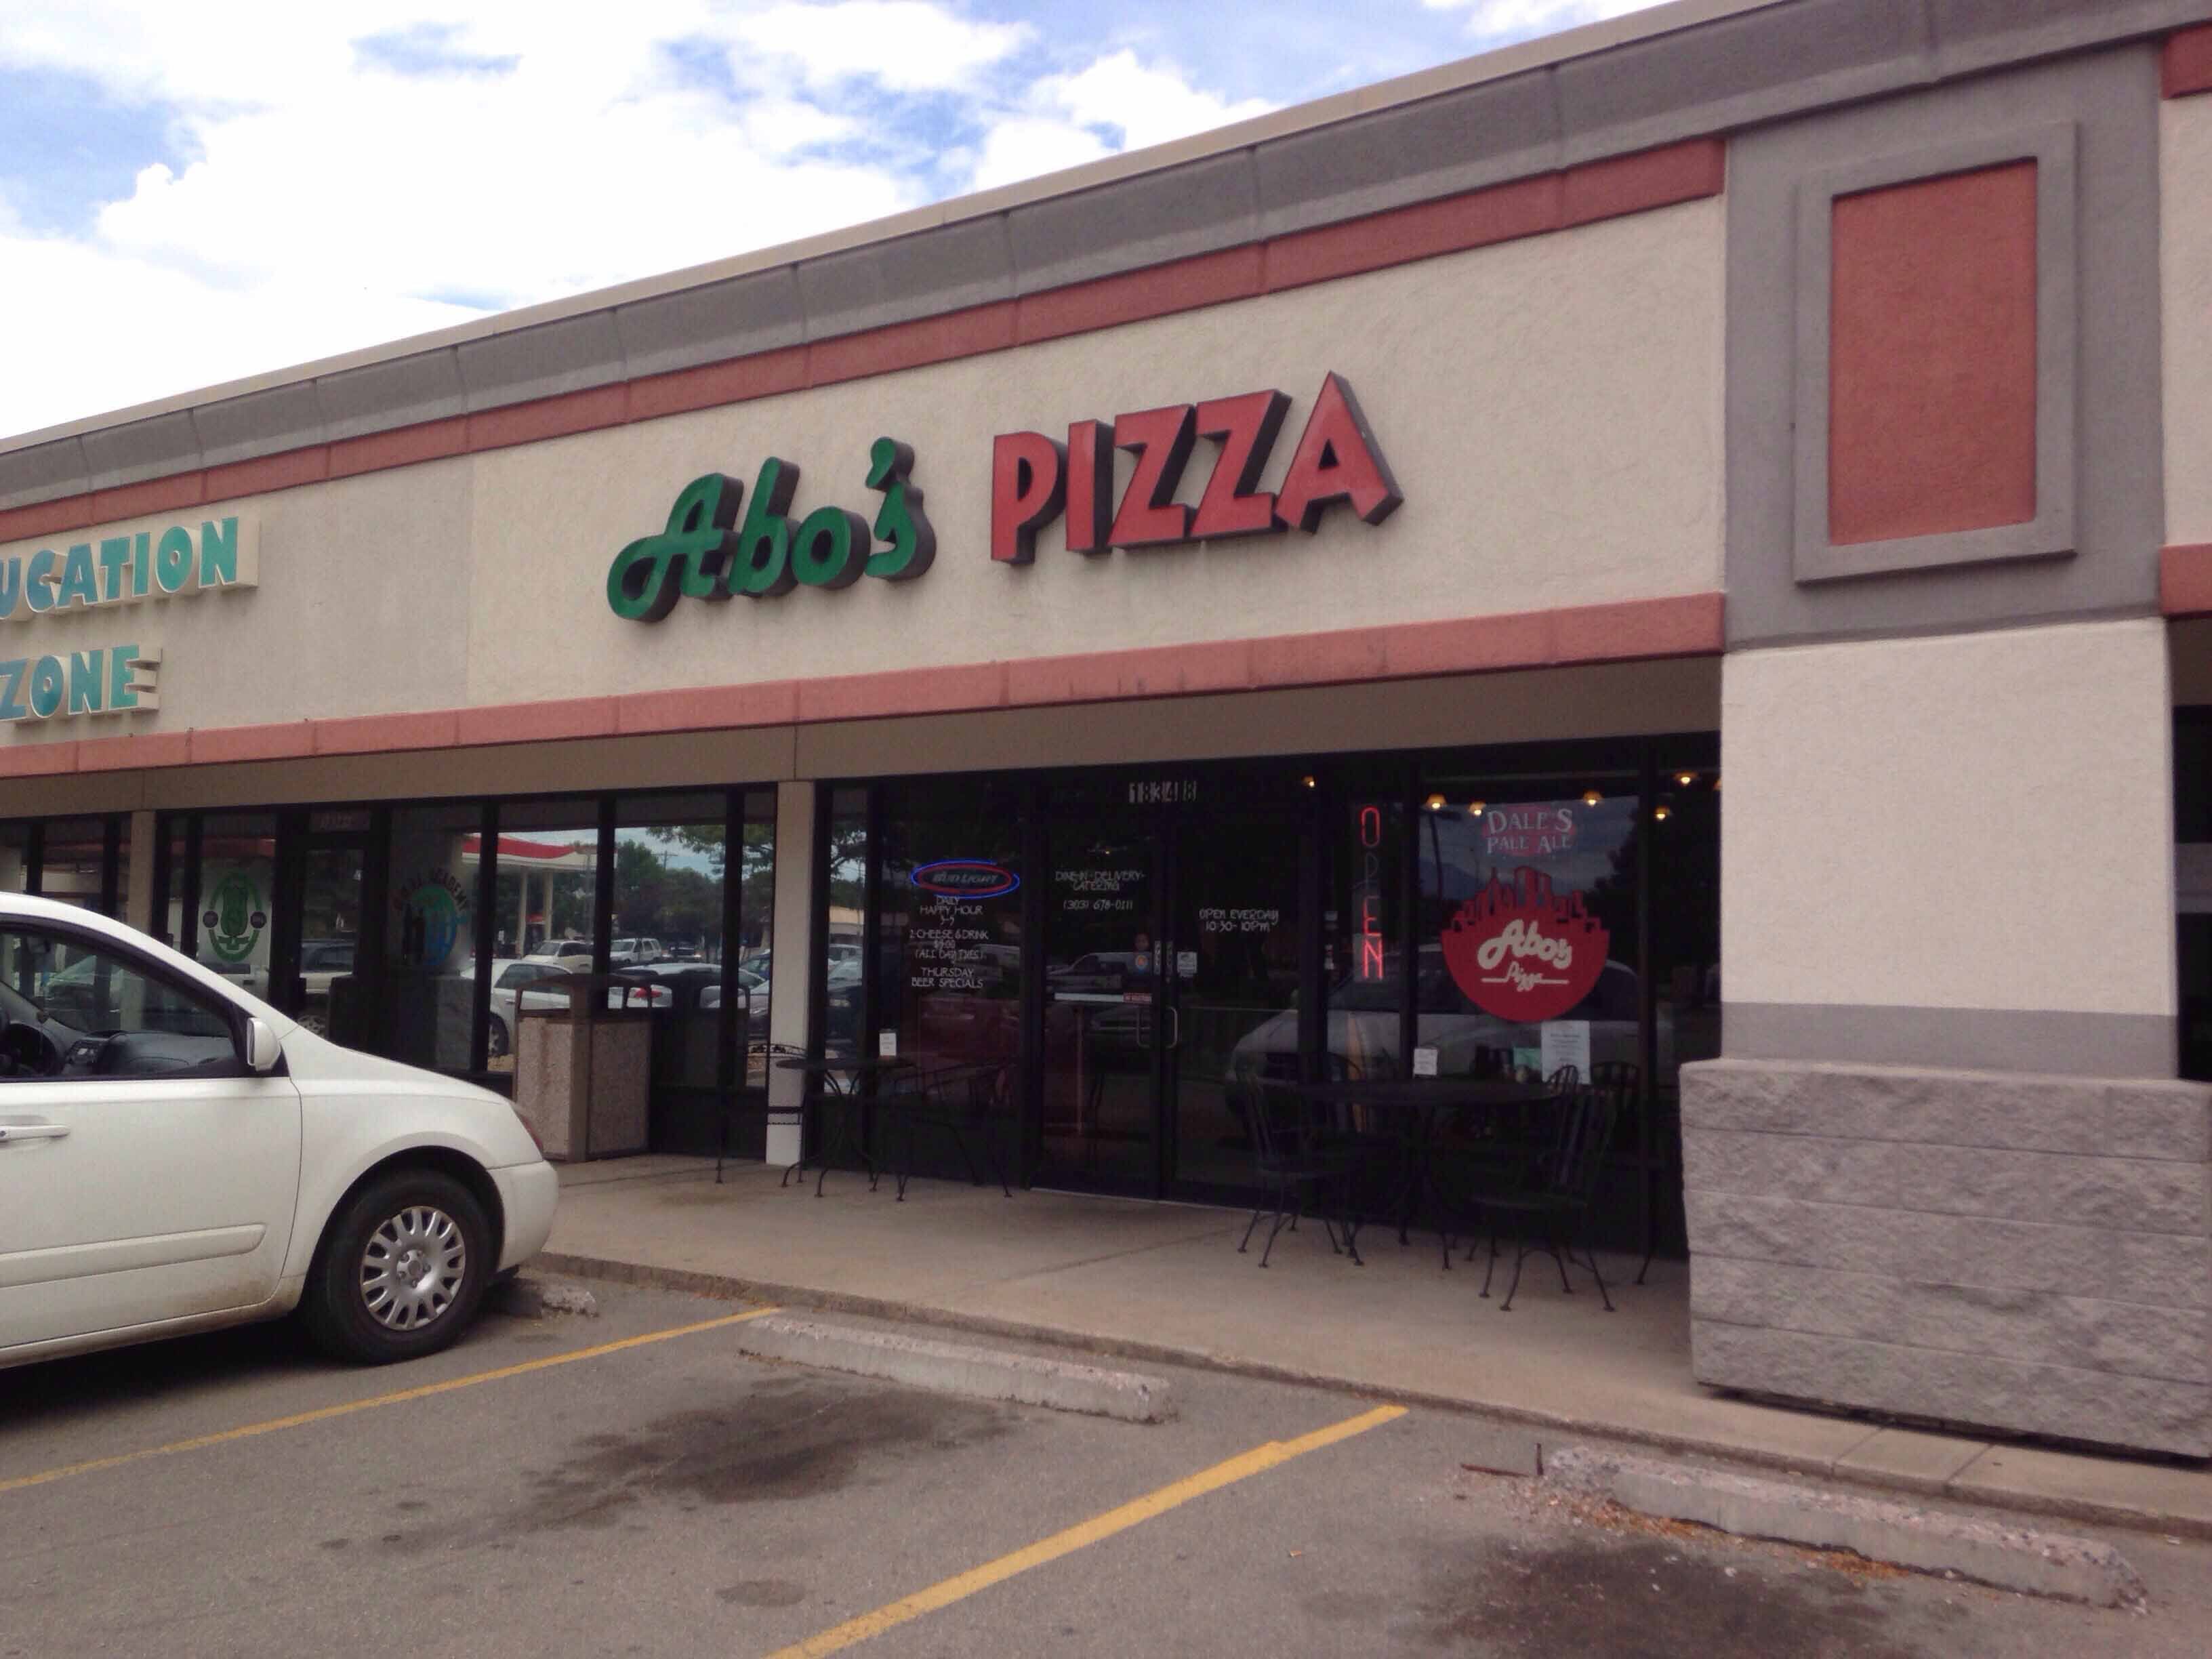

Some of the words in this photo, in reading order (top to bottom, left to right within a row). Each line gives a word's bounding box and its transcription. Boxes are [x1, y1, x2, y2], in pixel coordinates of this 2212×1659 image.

[607, 436, 935, 623] Abo's
[991, 370, 1404, 565] PIZZA
[0, 644, 146, 721] ZONE
[1361, 806, 1383, 980] OPEN
[920, 905, 949, 916] HAPPY
[954, 905, 983, 916] HOUR
[1199, 908, 1226, 920] OPEN
[962, 929, 989, 941] DRINK
[921, 966, 975, 977] THURSDAY
[911, 978, 935, 988] BEER
[939, 978, 983, 989] SPECIALS
